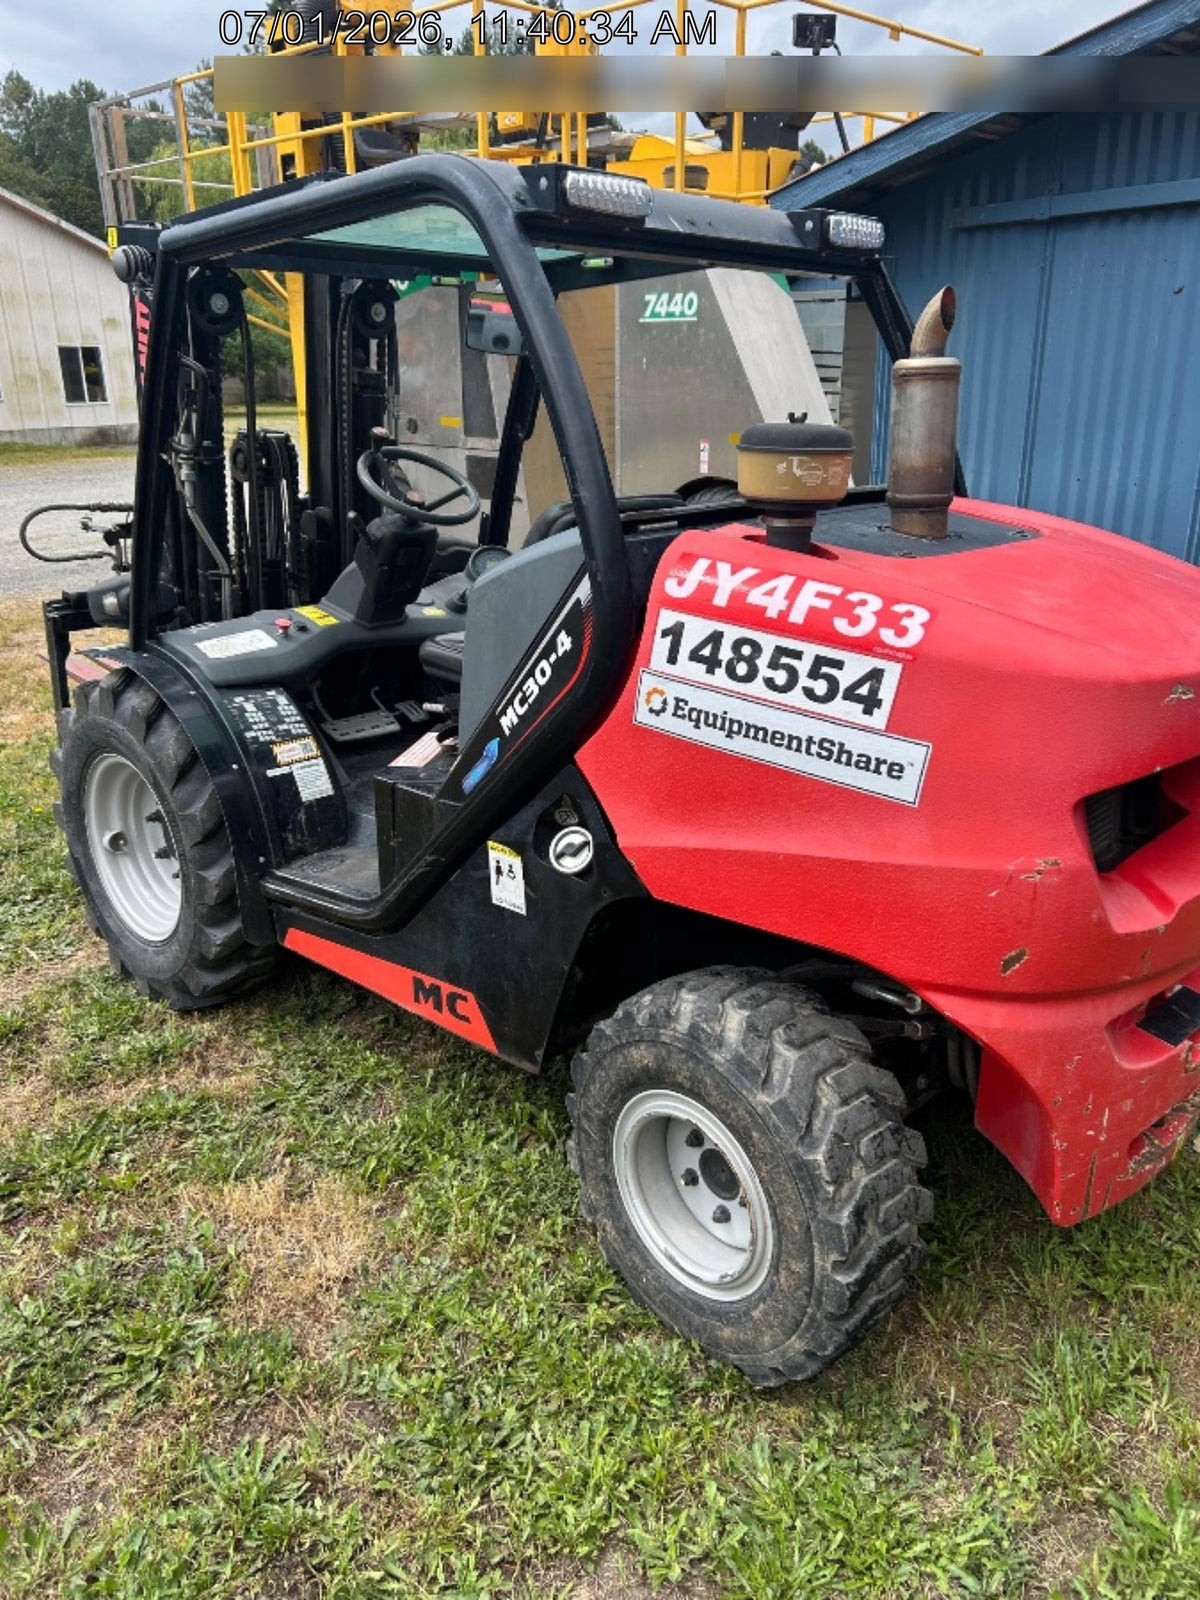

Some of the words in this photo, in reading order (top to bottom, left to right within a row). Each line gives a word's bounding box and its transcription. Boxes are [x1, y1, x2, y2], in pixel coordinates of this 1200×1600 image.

[643, 290, 699, 317] 7440
[663, 557, 931, 649] JY4F33
[499, 629, 573, 737] MC30-4
[659, 620, 886, 717] 148554
[670, 696, 906, 781] EquipmentShare
[412, 976, 472, 1025] MC
